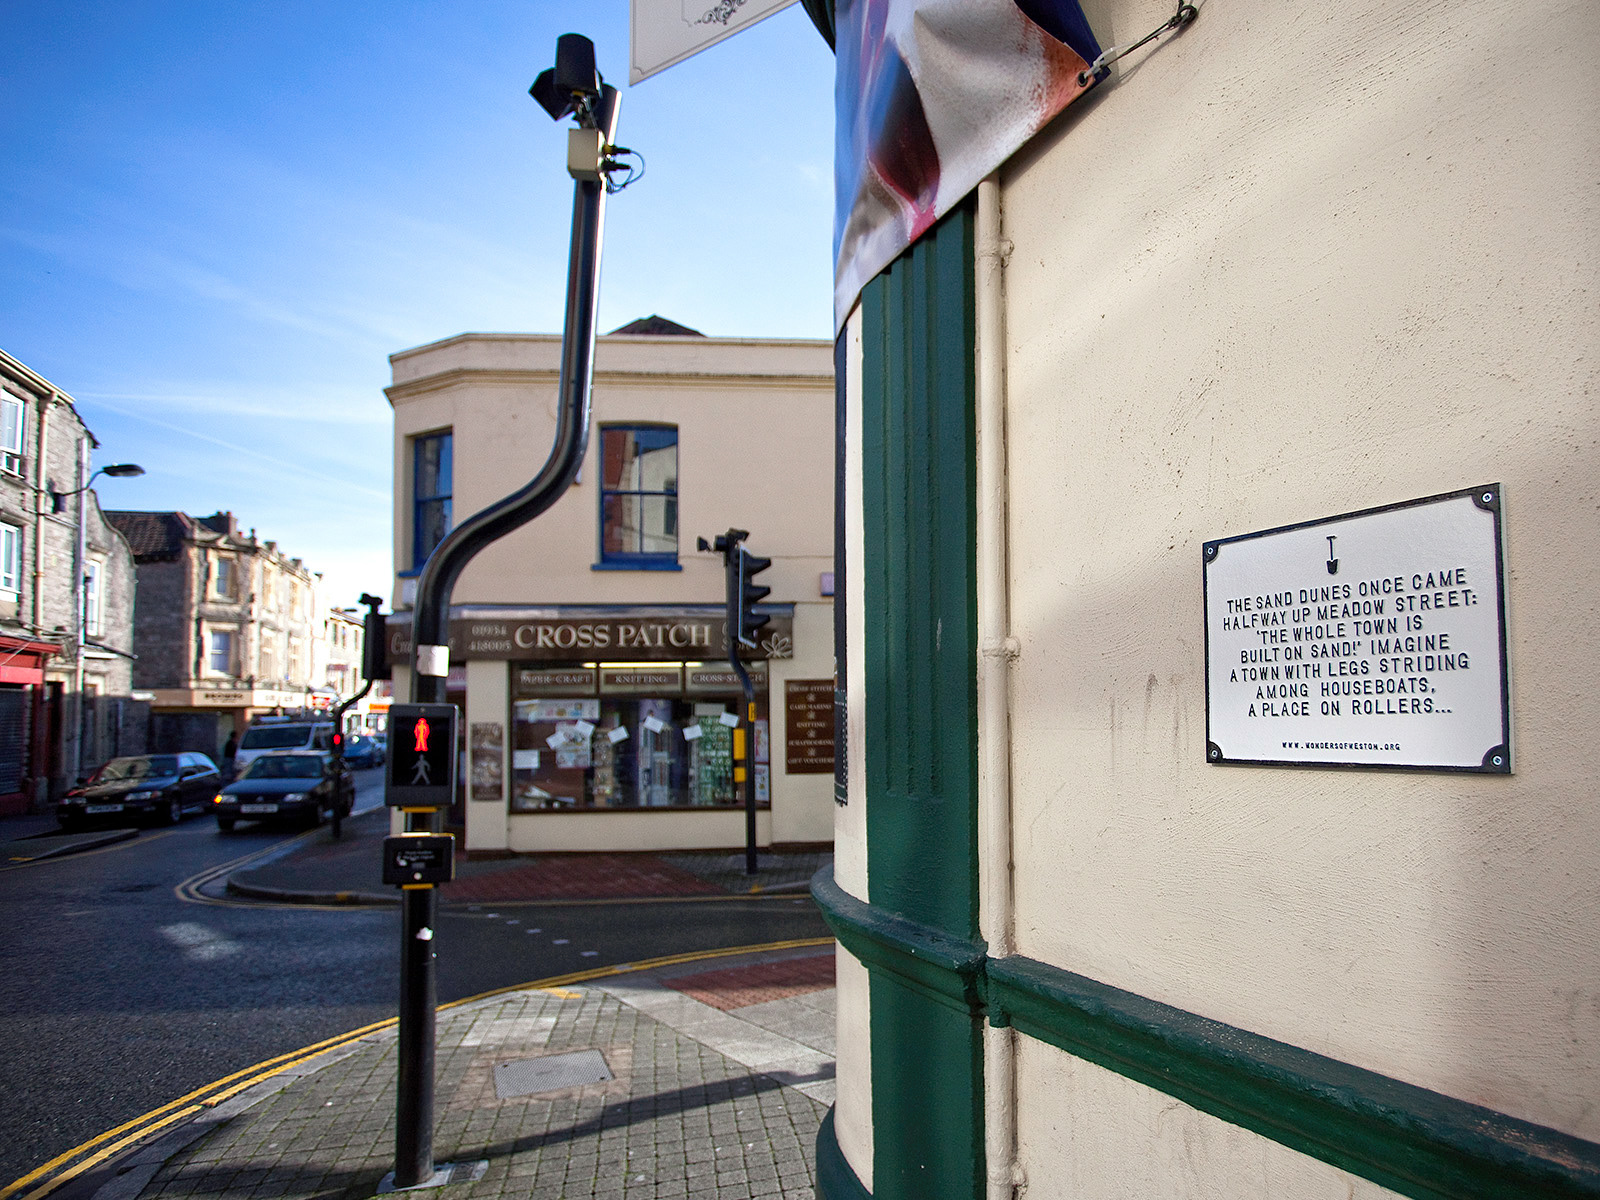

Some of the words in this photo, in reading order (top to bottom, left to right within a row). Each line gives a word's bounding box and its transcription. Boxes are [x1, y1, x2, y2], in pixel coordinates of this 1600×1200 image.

[1227, 597, 1252, 613] THE
[1256, 592, 1292, 608] SAND
[1300, 584, 1350, 603] DUNES
[1359, 577, 1403, 596] ONCE
[1412, 568, 1466, 590] CAME
[1223, 611, 1286, 630] HALFWAY
[1292, 608, 1310, 622] UP
[1317, 600, 1384, 620] MEADOW
[1396, 589, 1478, 612] STREET:
[514, 624, 611, 649] CROSS
[617, 624, 712, 648] PATCH
[1293, 622, 1345, 641] WHOLE
[1354, 618, 1398, 636] TOWN
[1406, 615, 1423, 630] IS
[1241, 647, 1278, 663] BUILT
[1284, 646, 1302, 660] ON
[1370, 634, 1450, 654] IMAGINE
[615, 674, 669, 684] KNITTING
[1230, 669, 1238, 682] A
[1242, 667, 1280, 681] TOWN
[1285, 664, 1322, 679] WITH
[1328, 660, 1369, 676] LEGS
[1380, 653, 1470, 673] STRIDING
[1256, 683, 1308, 699] AMONG
[1321, 678, 1436, 696] HOUSEBOATS,
[1248, 703, 1257, 716] A
[1262, 702, 1310, 716] PLACE
[1321, 700, 1340, 715] ON
[1352, 698, 1452, 715] ROLLERS...
[1282, 741, 1400, 751] WWW.WONDERSOFWESTON.ORG
